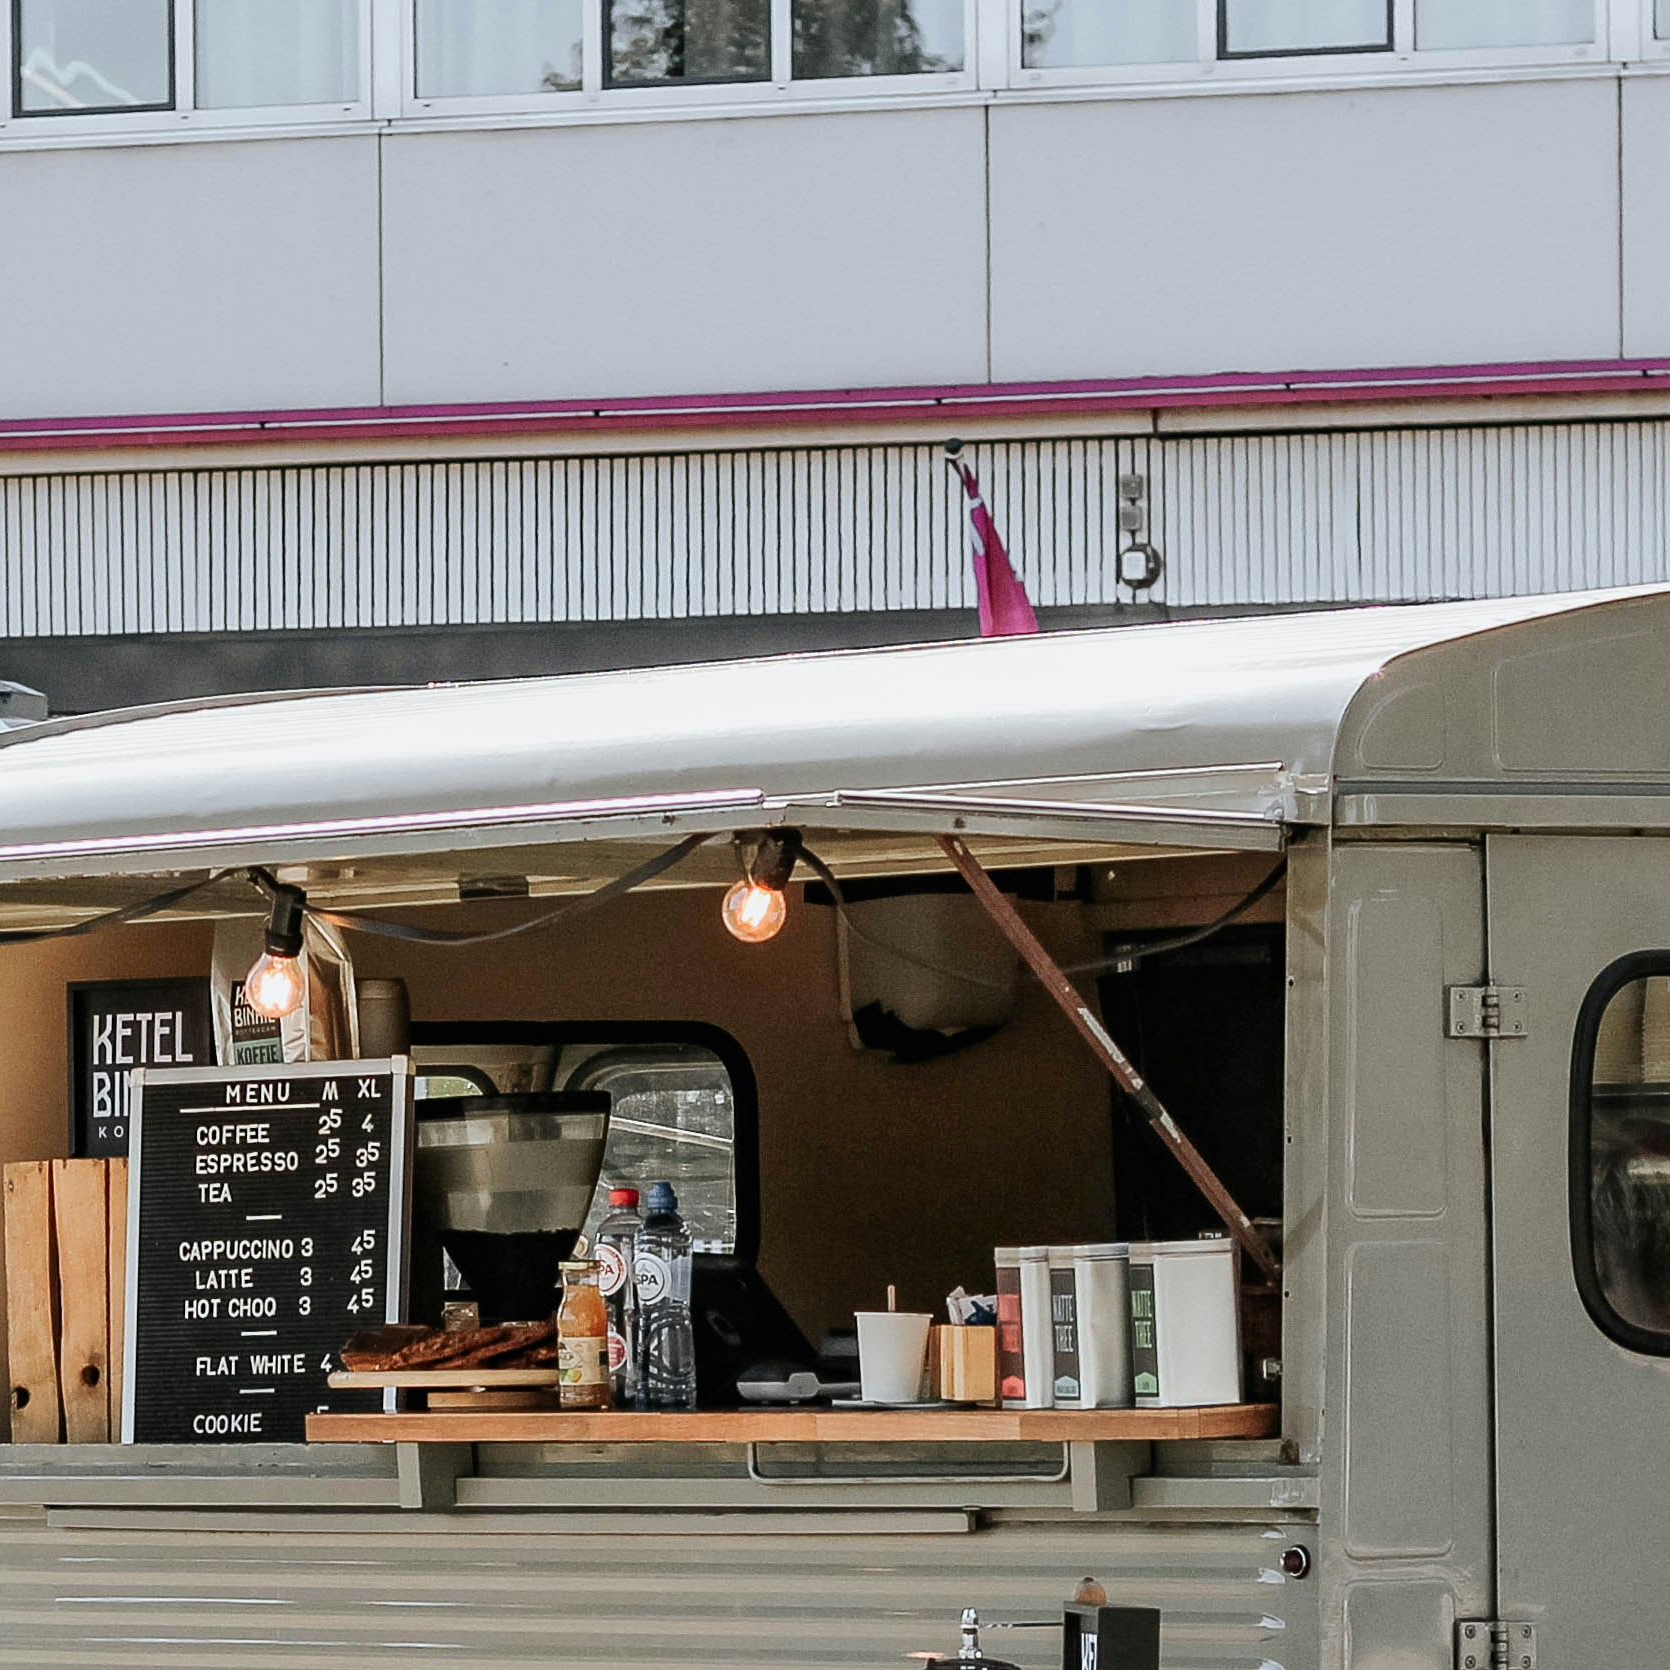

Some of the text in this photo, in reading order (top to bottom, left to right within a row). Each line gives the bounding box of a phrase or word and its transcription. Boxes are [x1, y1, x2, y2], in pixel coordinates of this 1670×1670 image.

[92, 1011, 194, 1065] KETEL
[236, 1044, 278, 1064] KOFFIE
[226, 1078, 381, 1104] MENU M XL
[196, 1123, 270, 1146] COFFEE
[361, 1113, 374, 1133] 4
[195, 1151, 299, 1175] ESPRESSO
[198, 1182, 232, 1203] TEA
[179, 1238, 294, 1262] CAPPUCCINO
[300, 1237, 314, 1258] 3
[195, 1267, 254, 1290] LATTE
[299, 1266, 313, 1286] 3
[184, 1298, 221, 1319] HOT
[298, 1295, 312, 1316] 3
[195, 1356, 239, 1377] FLAT
[250, 1353, 306, 1375] WHITE
[193, 1412, 263, 1434] COOKIE
